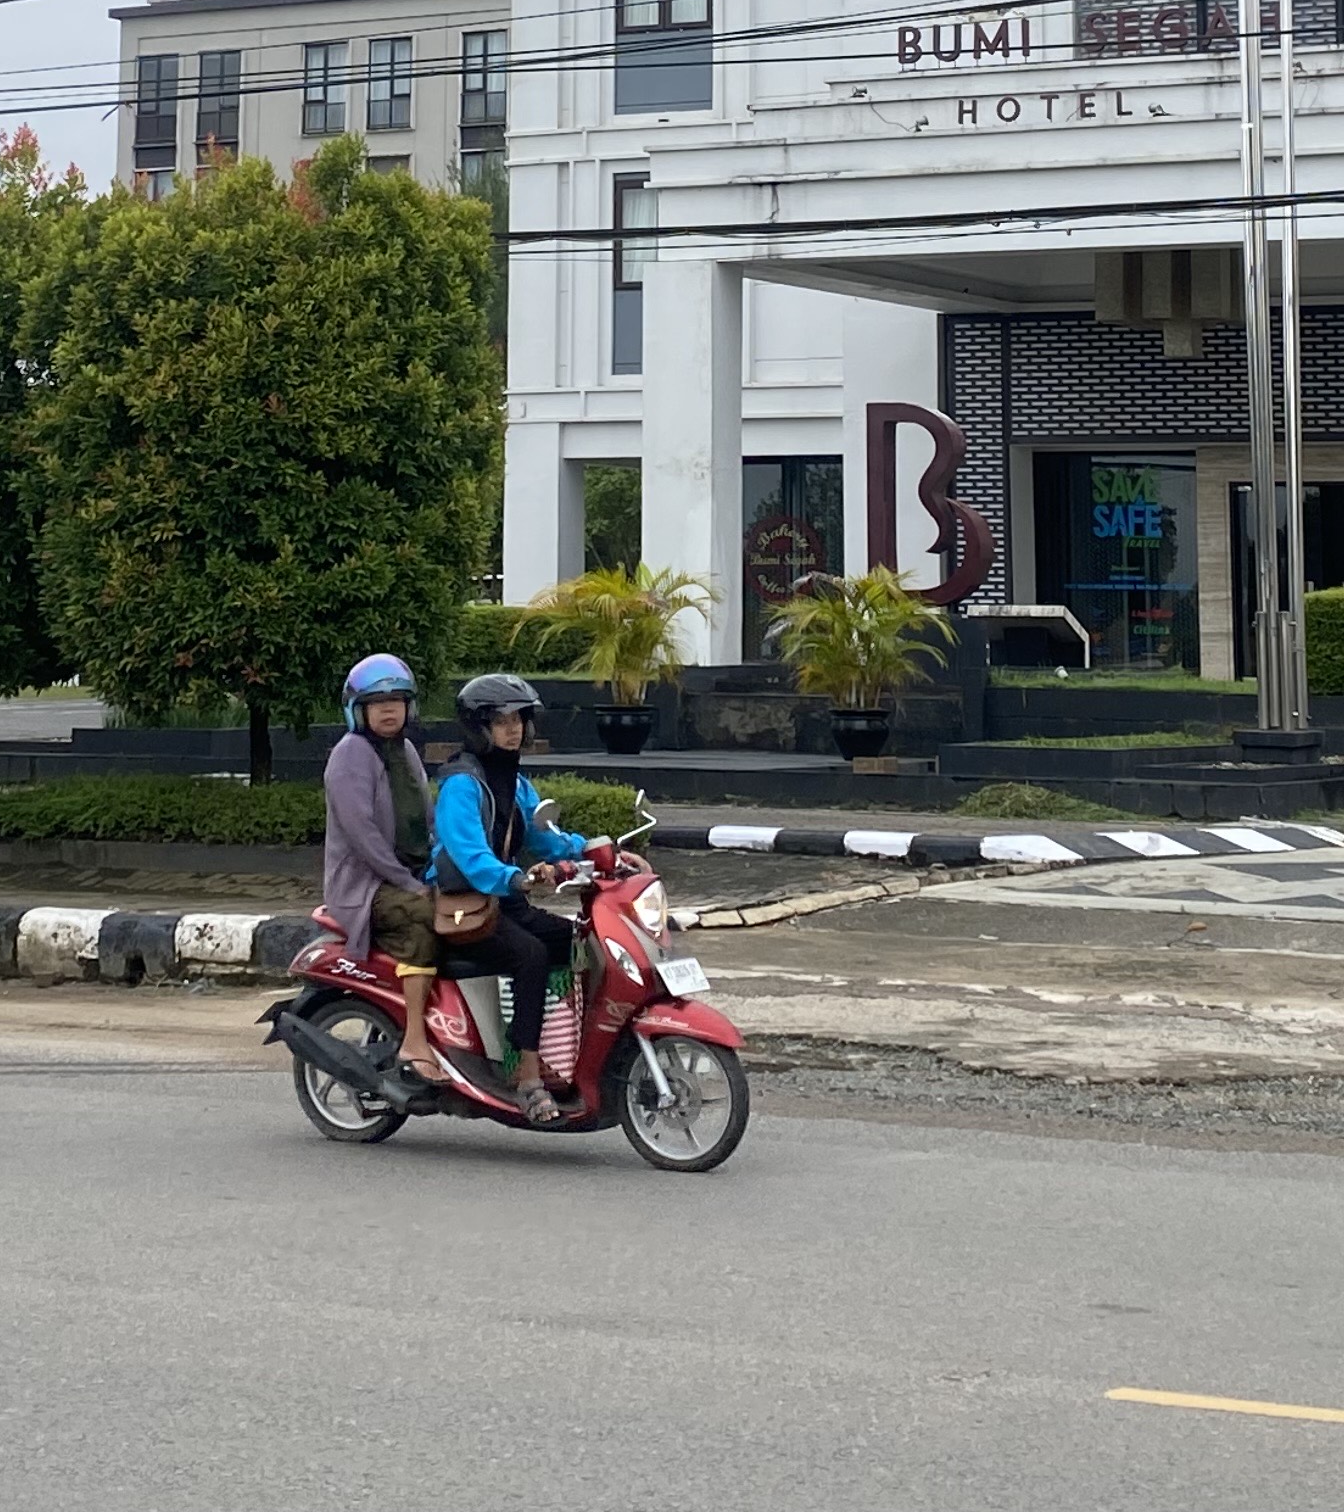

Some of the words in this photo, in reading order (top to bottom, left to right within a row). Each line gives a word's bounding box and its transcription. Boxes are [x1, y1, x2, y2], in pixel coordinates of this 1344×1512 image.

[897, 17, 1030, 65] BUMI
[957, 91, 1134, 125] HOTEL
[1091, 466, 1161, 503] SAVE
[866, 402, 997, 607] B
[1092, 504, 1163, 537] SAFE
